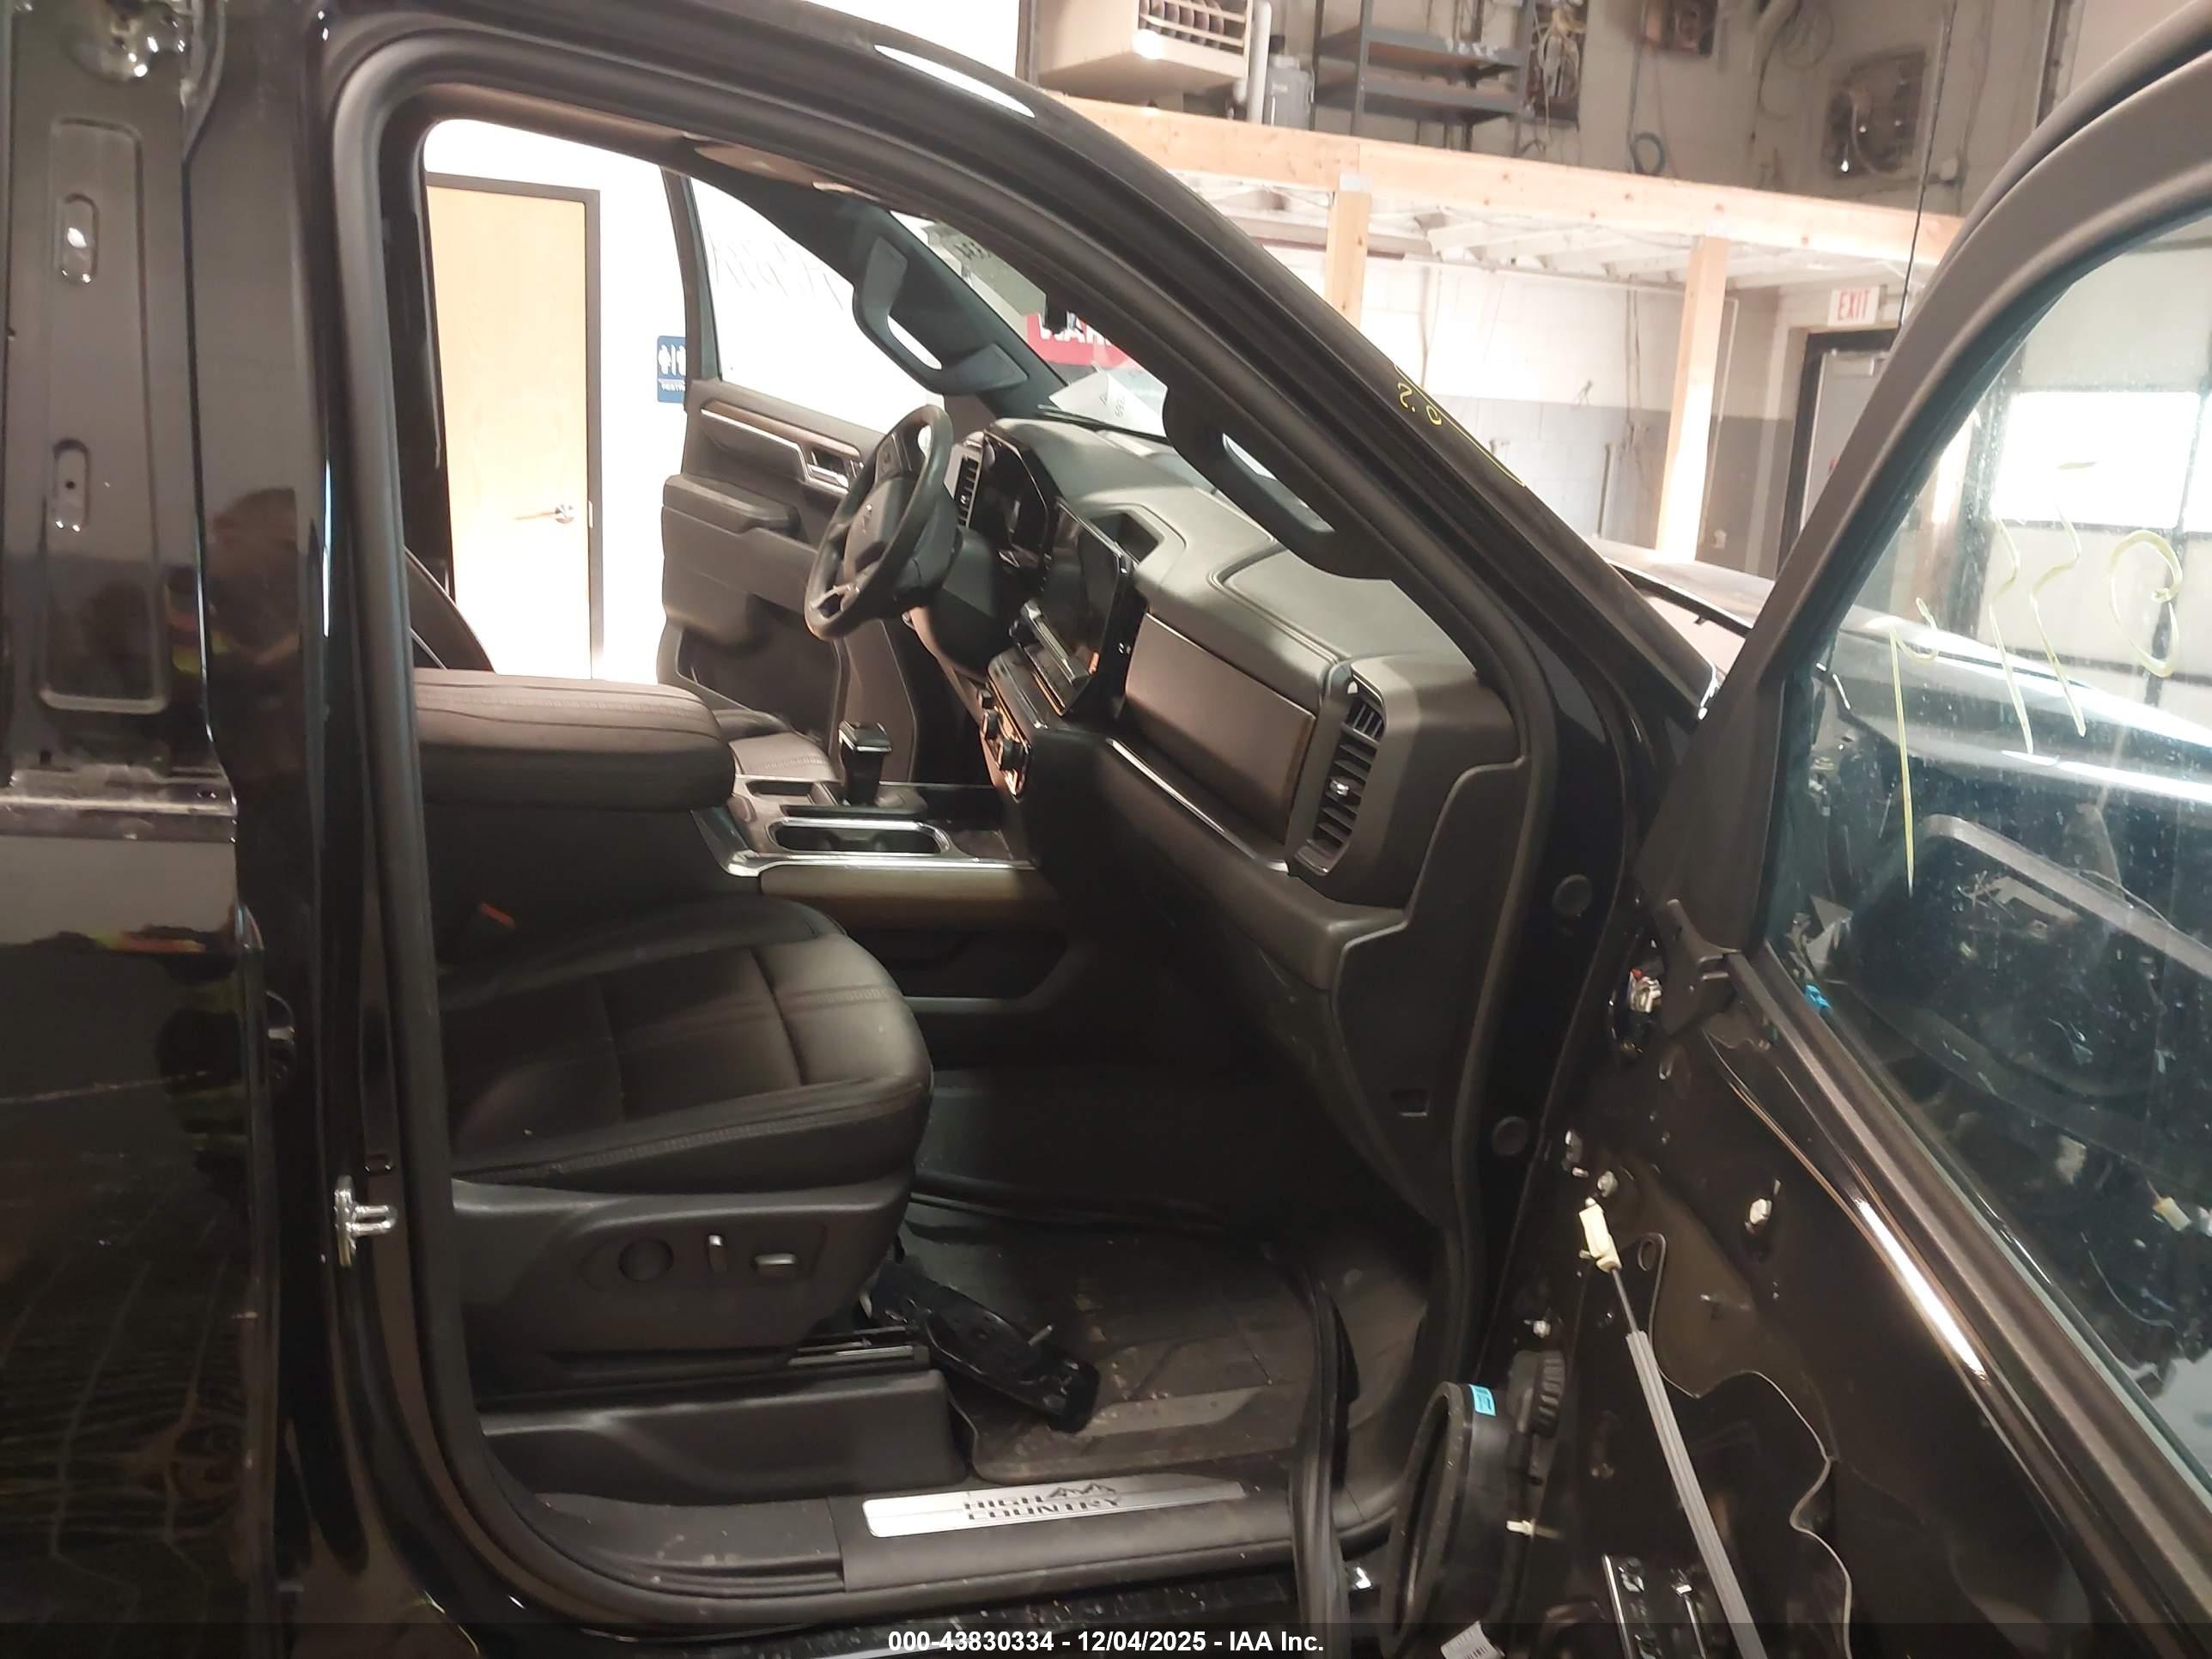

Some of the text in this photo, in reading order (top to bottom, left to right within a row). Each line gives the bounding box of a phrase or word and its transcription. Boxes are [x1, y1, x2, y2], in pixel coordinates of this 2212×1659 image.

[1837, 290, 1869, 320] EXIT
[963, 1495, 1045, 1510] HIGH
[967, 1497, 1121, 1521] COUNTRY
